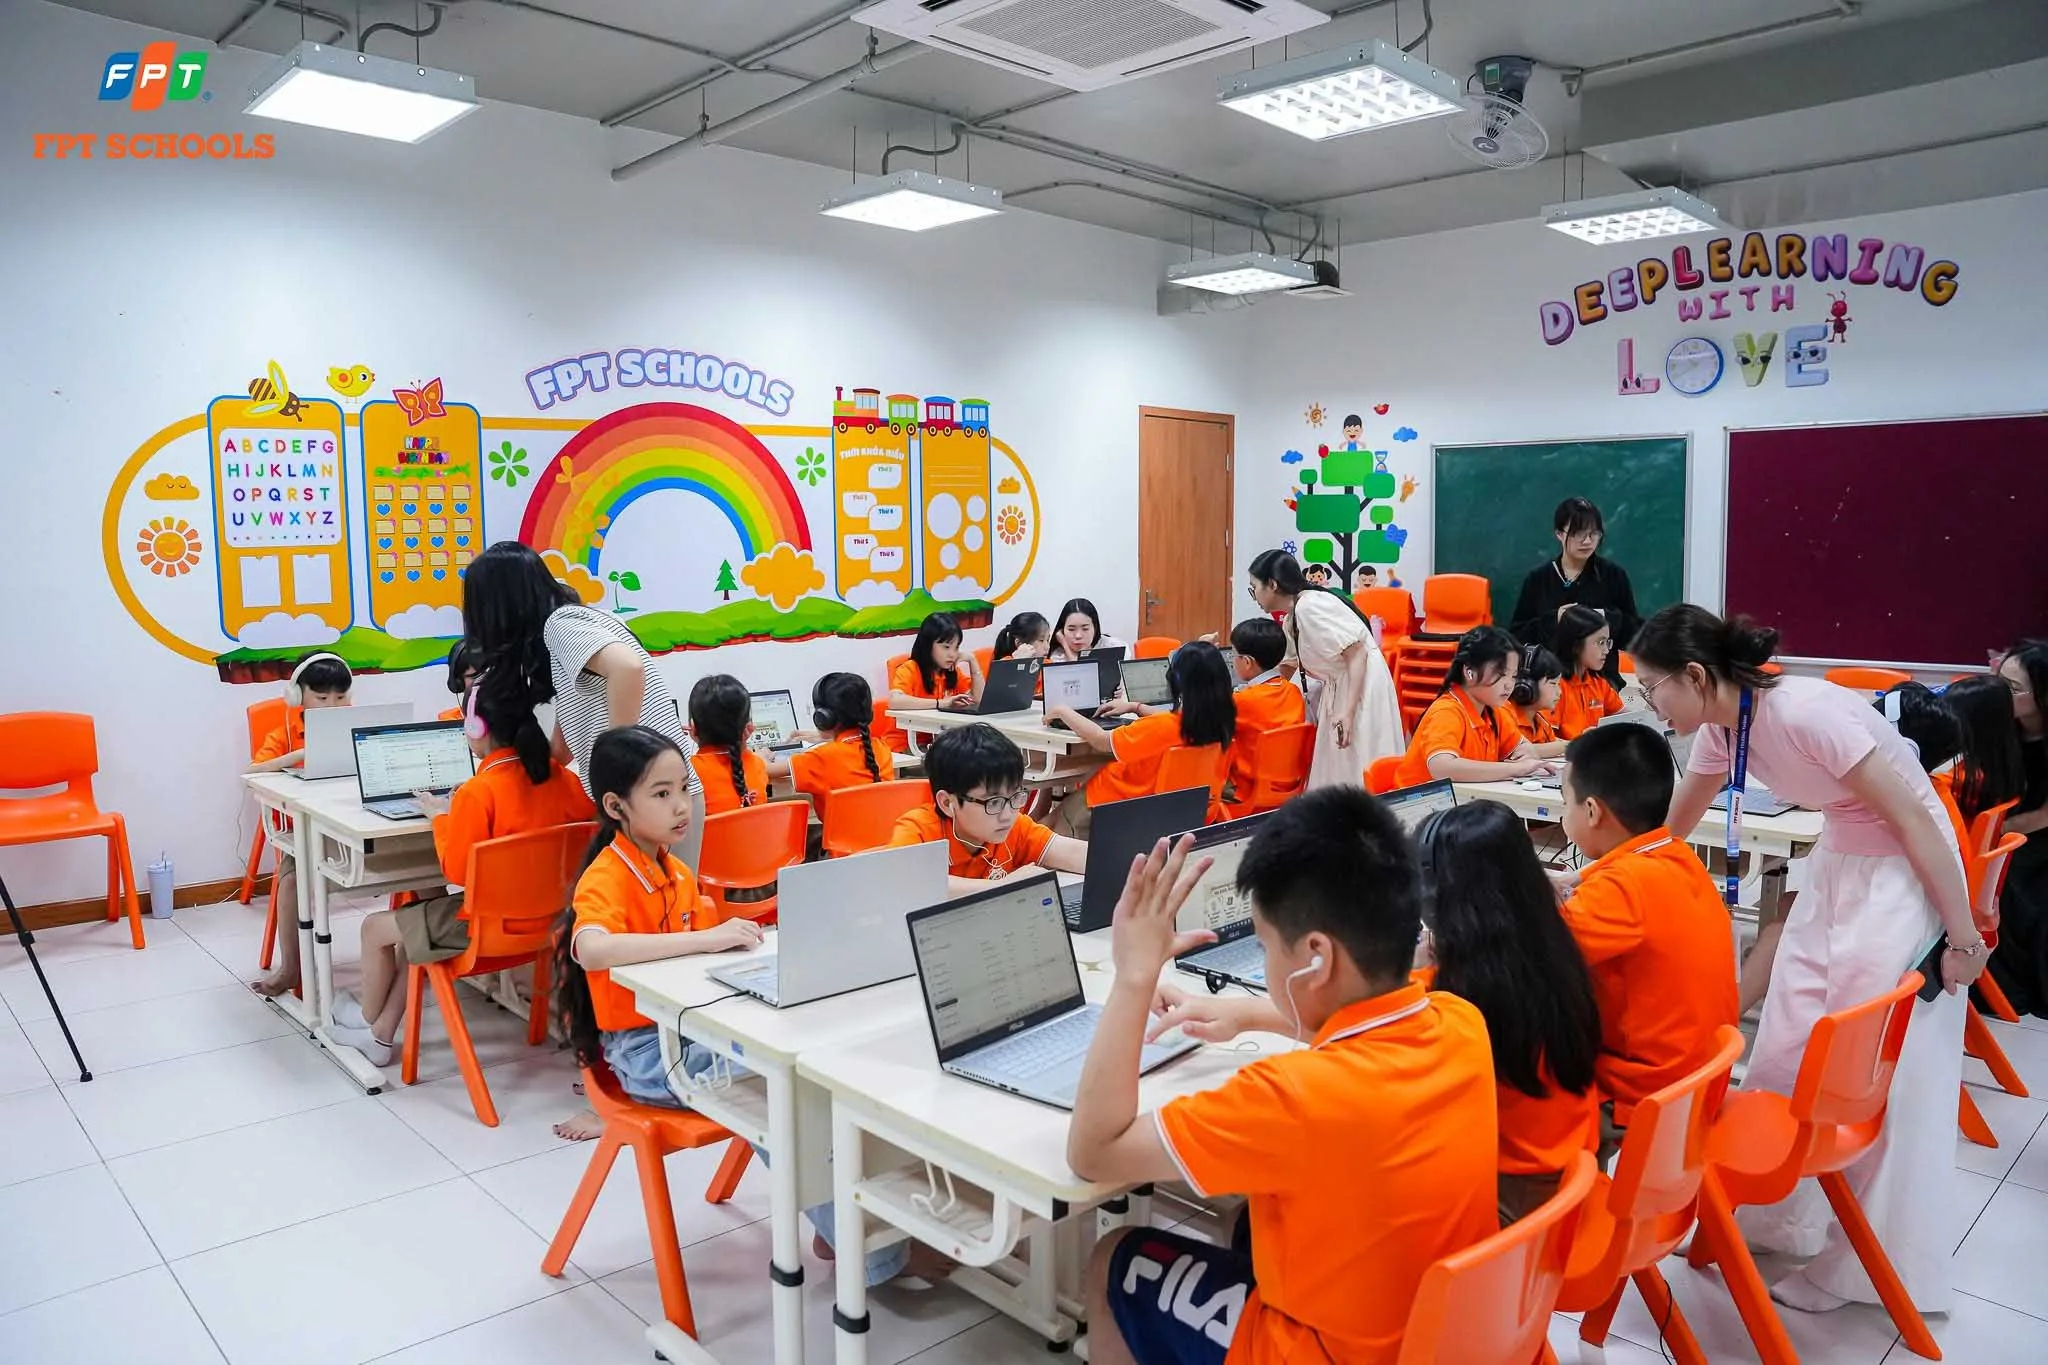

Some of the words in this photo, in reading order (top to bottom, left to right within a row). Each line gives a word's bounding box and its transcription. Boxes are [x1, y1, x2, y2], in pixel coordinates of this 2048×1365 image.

[1678, 284, 1794, 322] WITH
[526, 352, 611, 410] FPT
[616, 349, 795, 417] SCHOOLS
[1123, 1254, 1248, 1349] FILA
